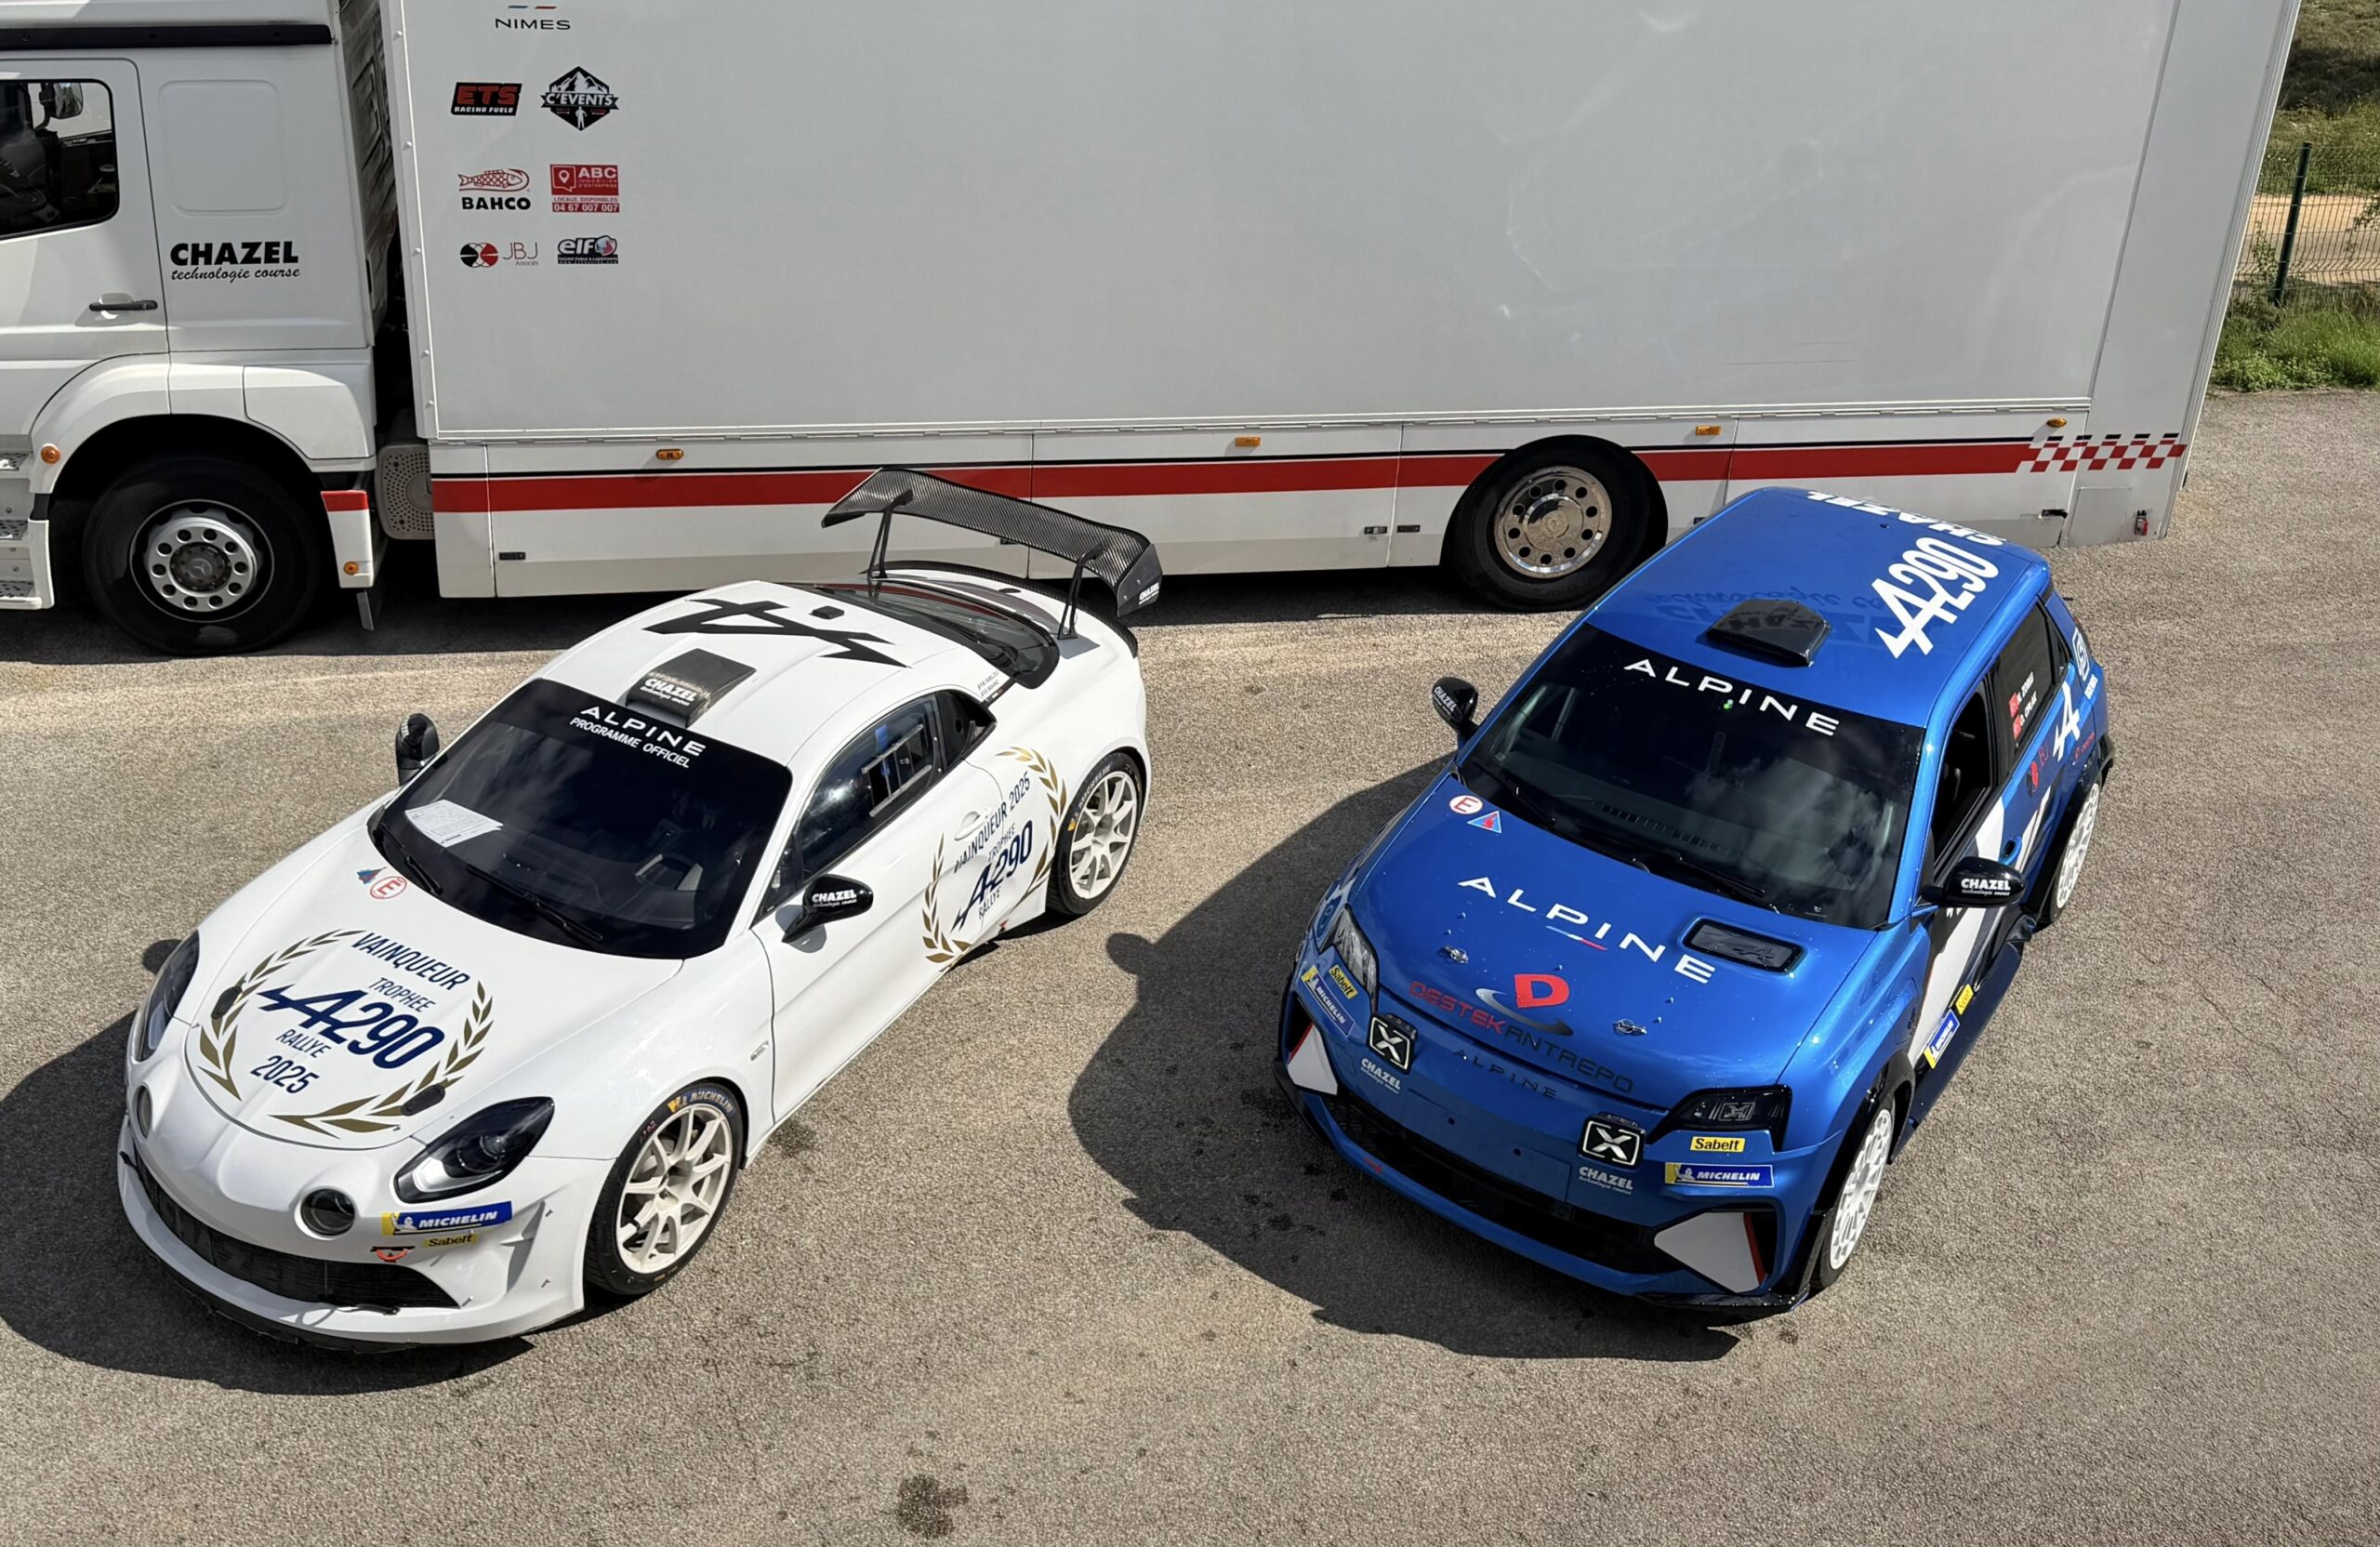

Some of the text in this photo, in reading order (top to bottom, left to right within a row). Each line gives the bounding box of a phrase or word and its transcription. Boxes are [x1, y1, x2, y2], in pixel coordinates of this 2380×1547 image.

[495, 18, 571, 31] NIMES
[456, 86, 519, 105] ETS
[546, 93, 613, 107] C'EVENTS
[454, 105, 514, 114] RACING FUELS
[578, 167, 617, 178] ABC
[461, 196, 531, 210] BAHCO
[553, 204, 618, 212] 04 67 007 007
[170, 241, 299, 267] CHAZEL
[502, 242, 538, 260] JBJ
[558, 238, 595, 255] elf
[171, 267, 301, 284] technologie course
[644, 679, 697, 702] CHAZEL
[1434, 686, 1457, 712] CHAZEL
[1623, 659, 1841, 736] ALPINE
[569, 717, 690, 768] PROGRAMME OFFICIEL
[580, 706, 707, 757] ALPINE
[1453, 797, 1478, 813] E
[954, 771, 1031, 874] VAINQUEUR 2025
[812, 889, 857, 904] CHAZEL
[1961, 878, 2011, 892] CHAZEL
[978, 887, 1002, 920] RALLYE
[1458, 877, 1716, 984] ALPINE
[351, 932, 470, 991] VAINQUEUR
[1331, 967, 1355, 995] Sabelt
[1514, 973, 1570, 1009] D
[1316, 985, 1346, 1025] MICHELIN
[257, 984, 445, 1069] A290
[276, 1028, 332, 1059] RALLYE
[250, 1054, 320, 1094] 2025
[1361, 1058, 1401, 1091] CHAZEL
[1451, 1050, 1557, 1100] ALPINE
[690, 1091, 734, 1114] MICHELIN
[1695, 1137, 1740, 1151] Sabelt
[1579, 1166, 1633, 1191] CHAZEL
[1697, 1170, 1761, 1182] MICHELIN
[418, 1210, 498, 1229] MICHELIN
[428, 1235, 473, 1248] Sabelt
